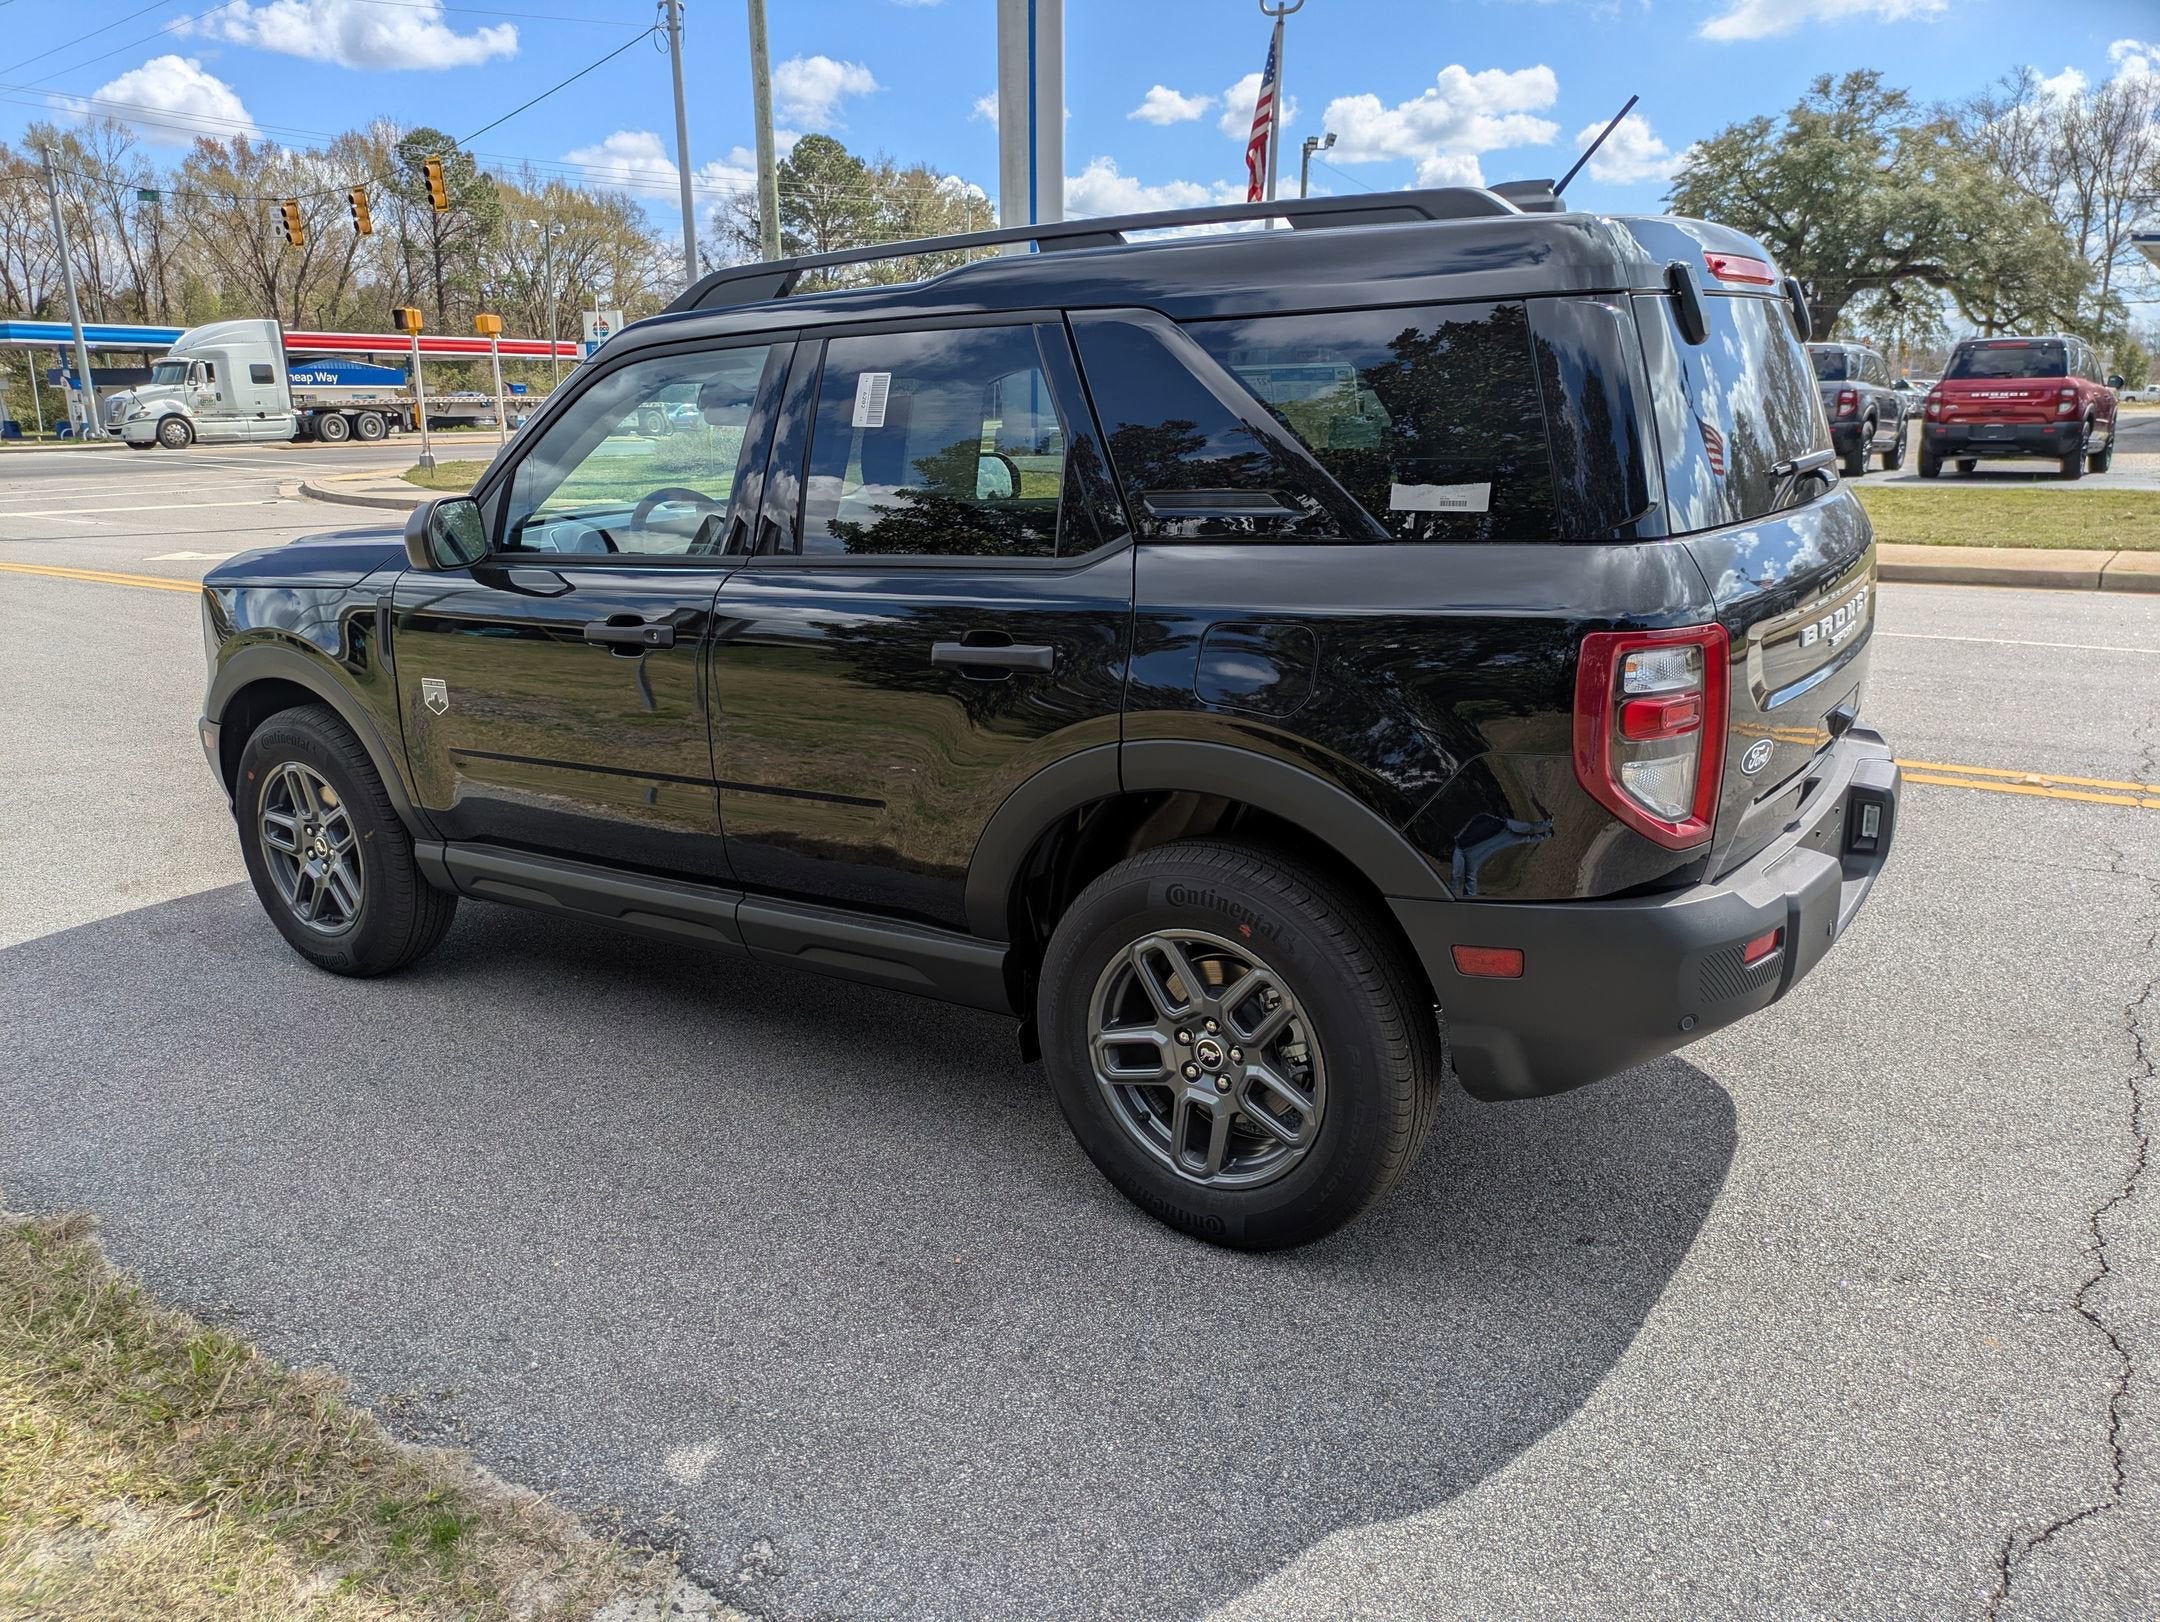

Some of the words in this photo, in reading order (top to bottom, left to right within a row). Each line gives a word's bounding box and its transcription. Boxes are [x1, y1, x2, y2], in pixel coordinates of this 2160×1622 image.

[315, 371, 338, 384] Way
[1748, 745, 1770, 769] Ford
[1165, 883, 1284, 943] Continental
